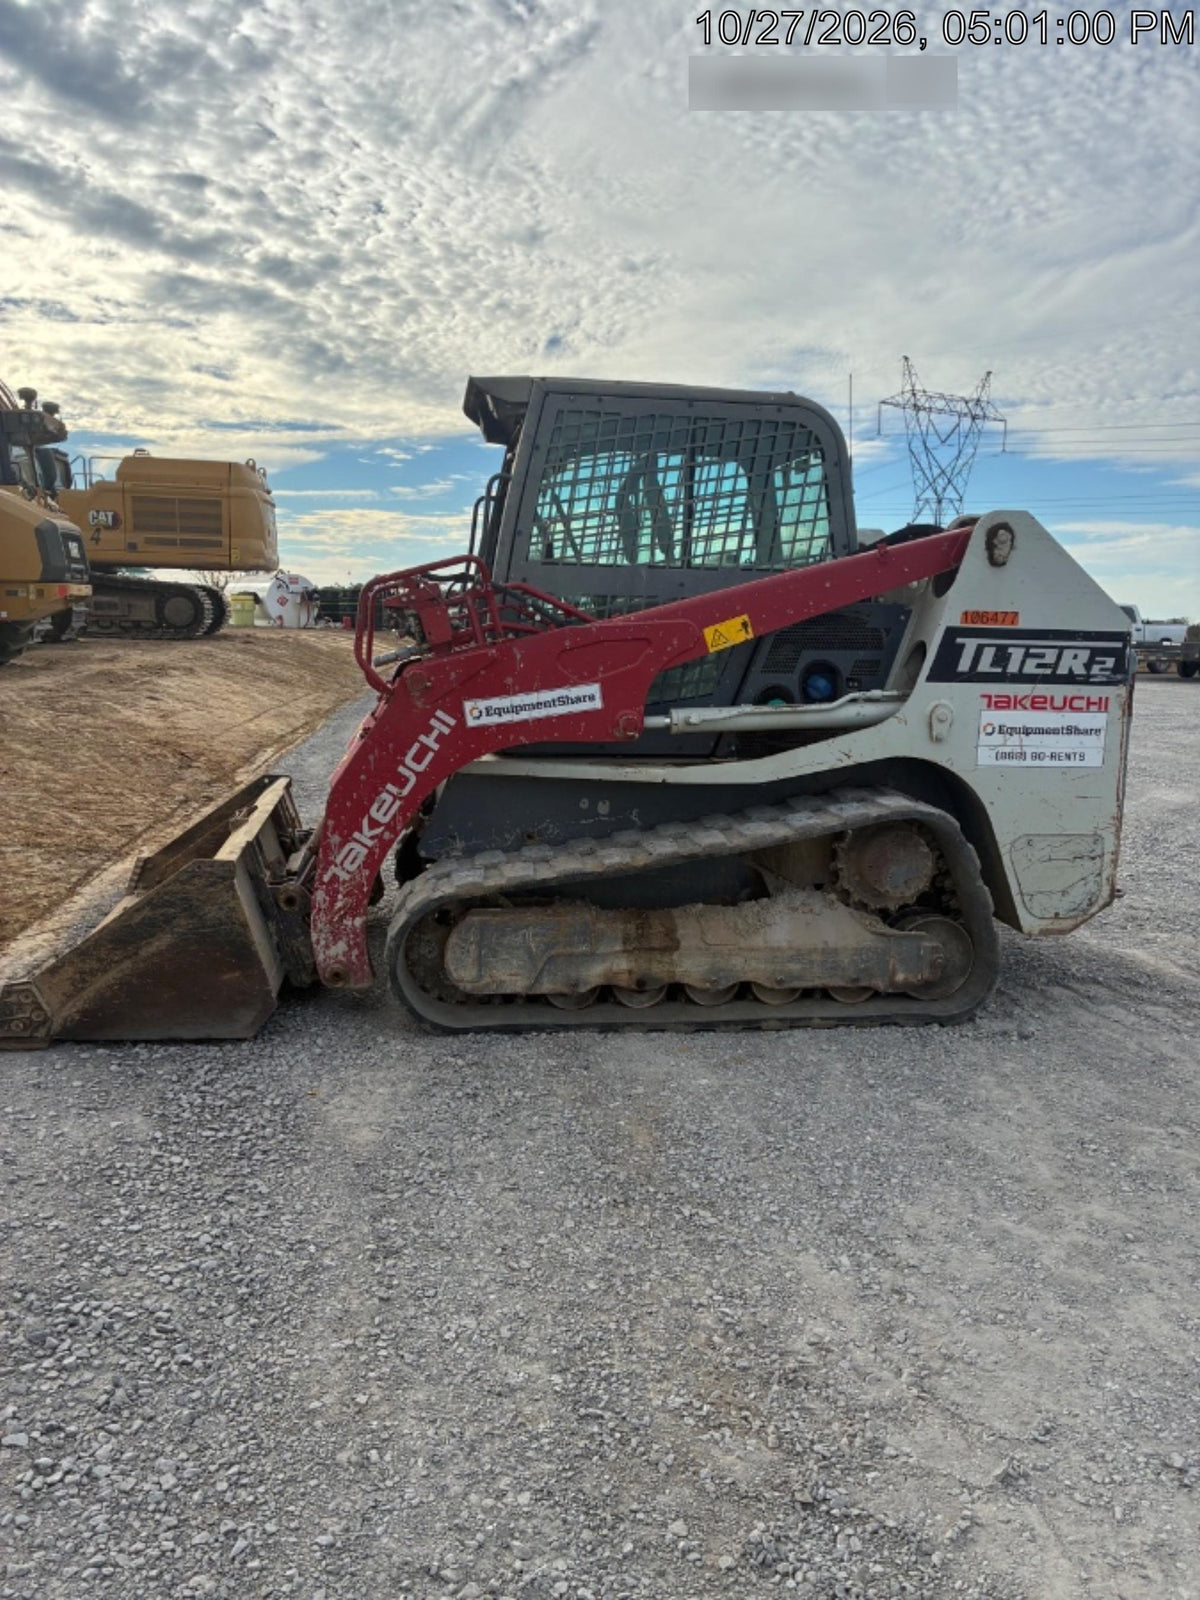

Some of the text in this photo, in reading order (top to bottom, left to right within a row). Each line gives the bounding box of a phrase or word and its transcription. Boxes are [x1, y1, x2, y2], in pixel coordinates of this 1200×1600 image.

[89, 510, 114, 527] CAT
[961, 610, 1019, 625] 106477
[484, 692, 597, 717] EquipmentShare
[997, 724, 1101, 737] EquipmentShare
